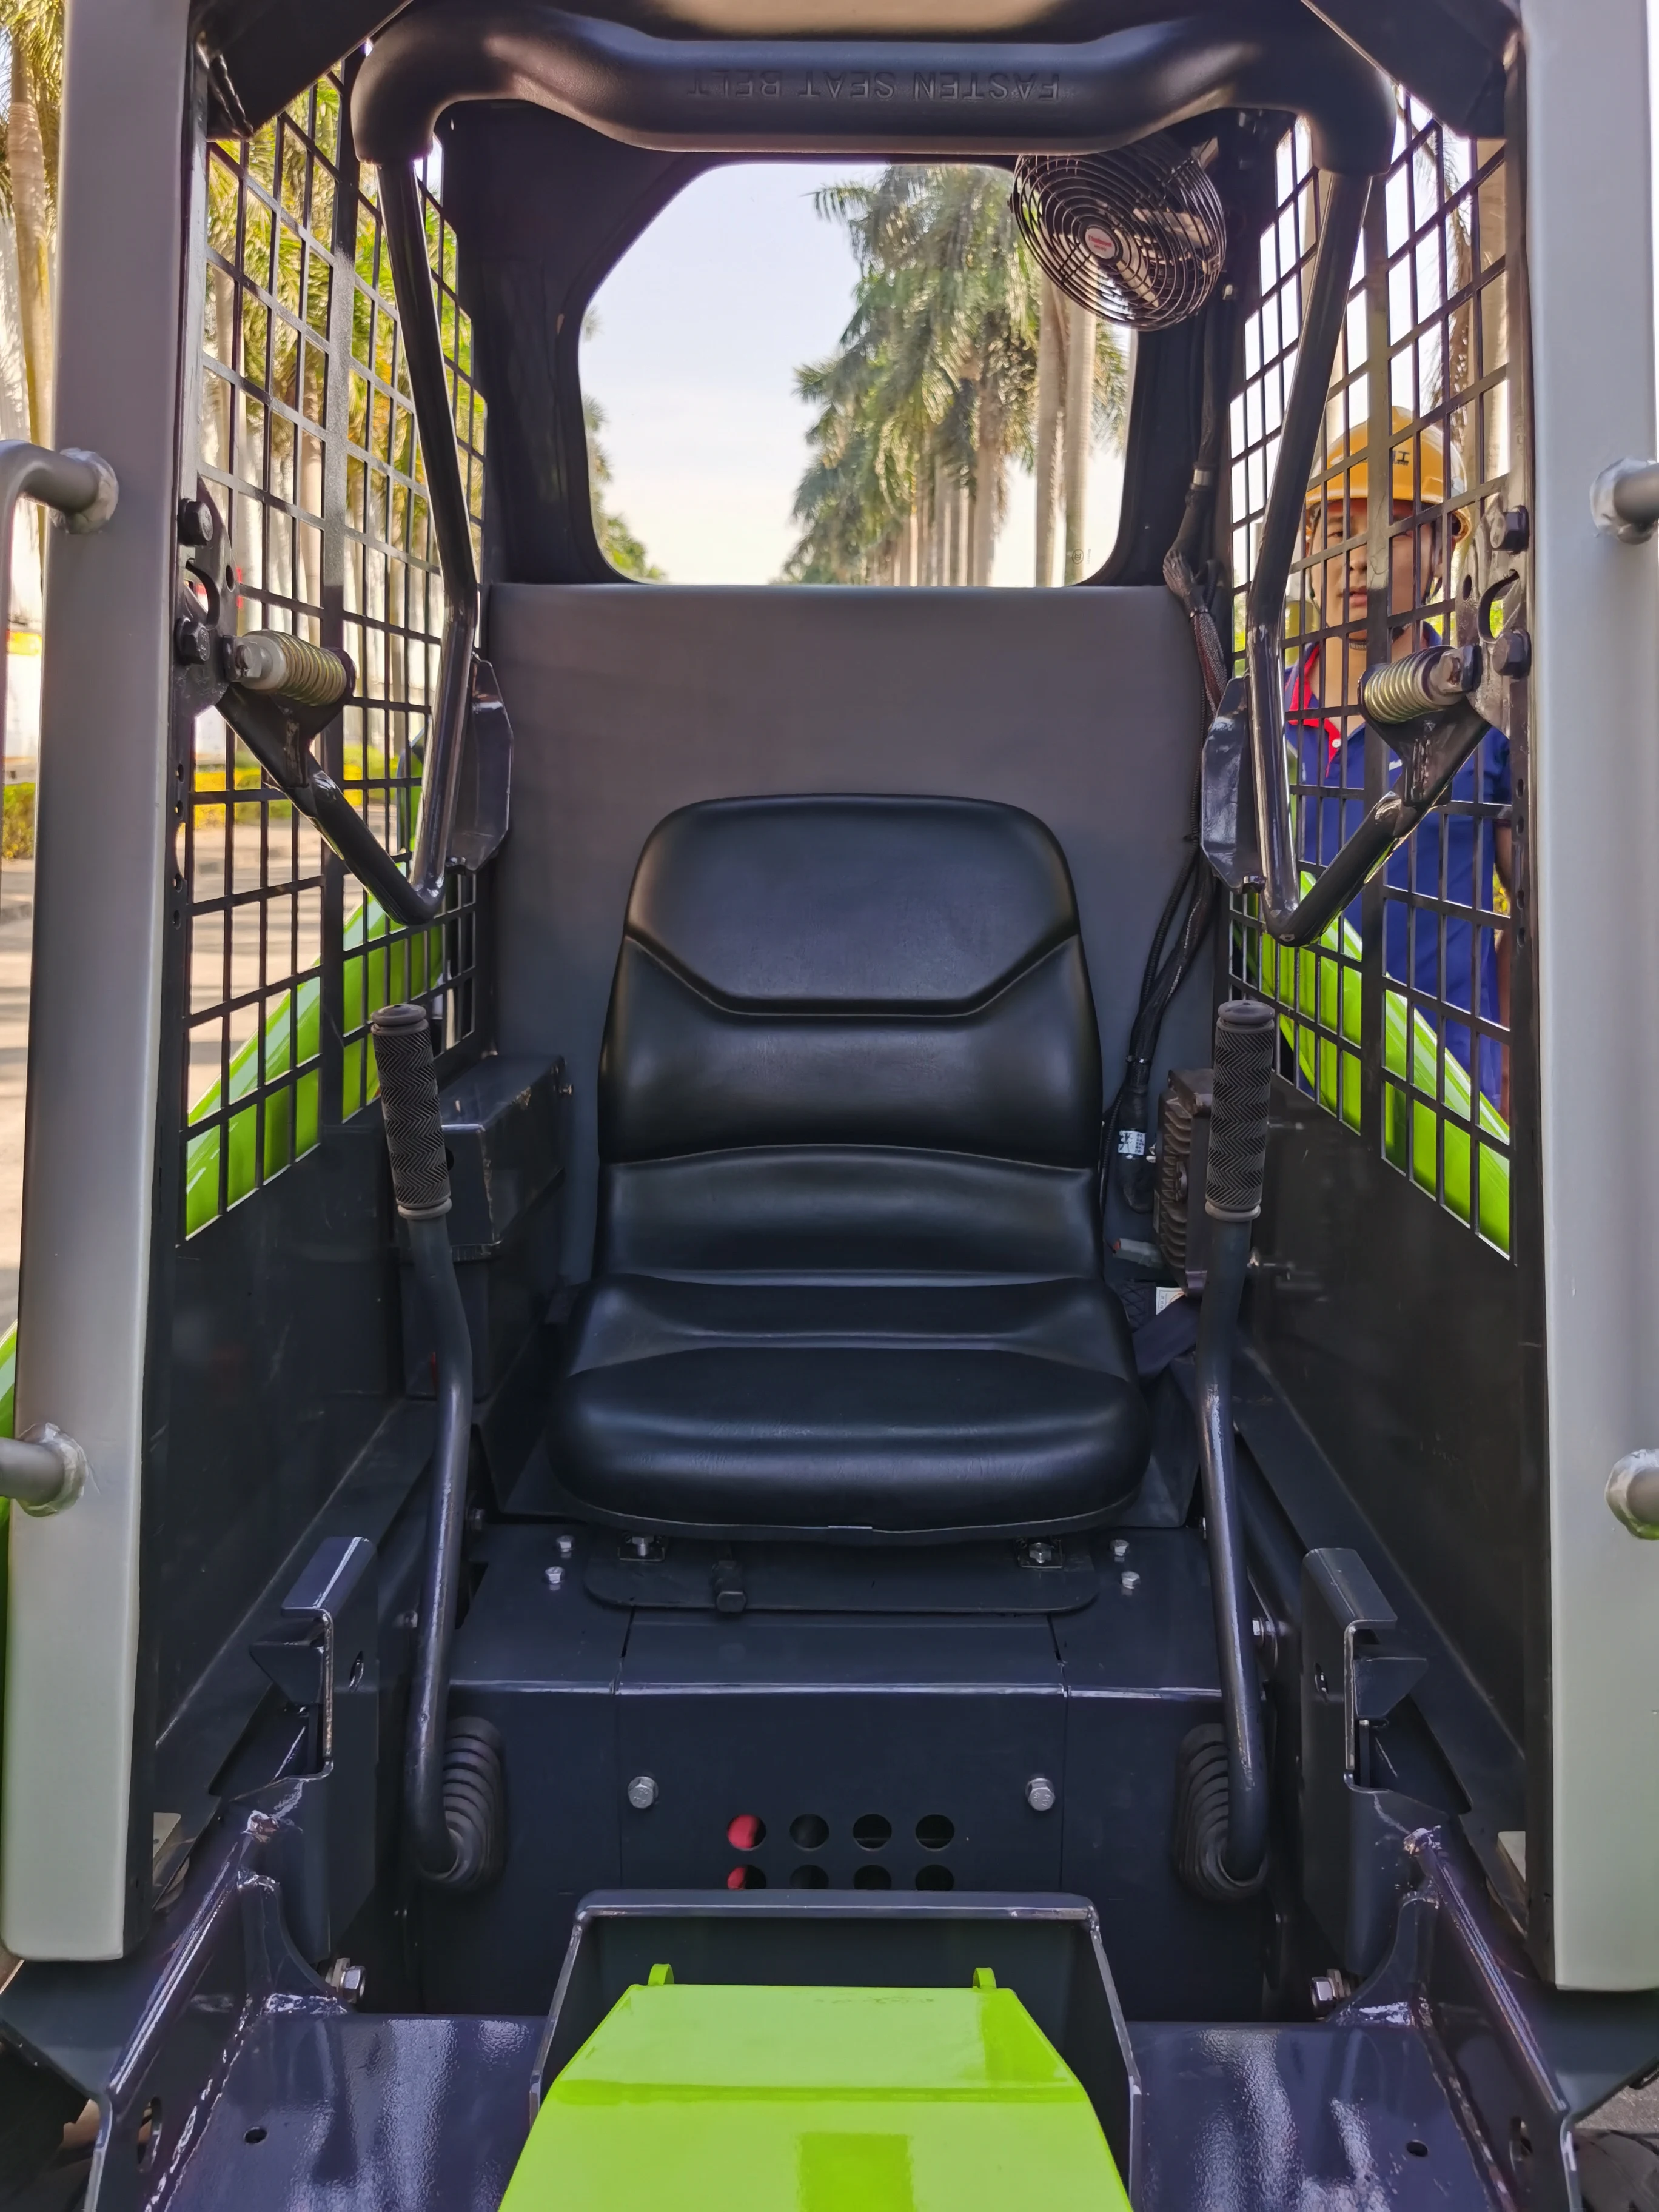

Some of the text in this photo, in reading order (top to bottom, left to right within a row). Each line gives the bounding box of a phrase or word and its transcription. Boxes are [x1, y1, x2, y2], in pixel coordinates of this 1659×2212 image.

[687, 69, 1060, 101] FASTEN SEAT BELT
